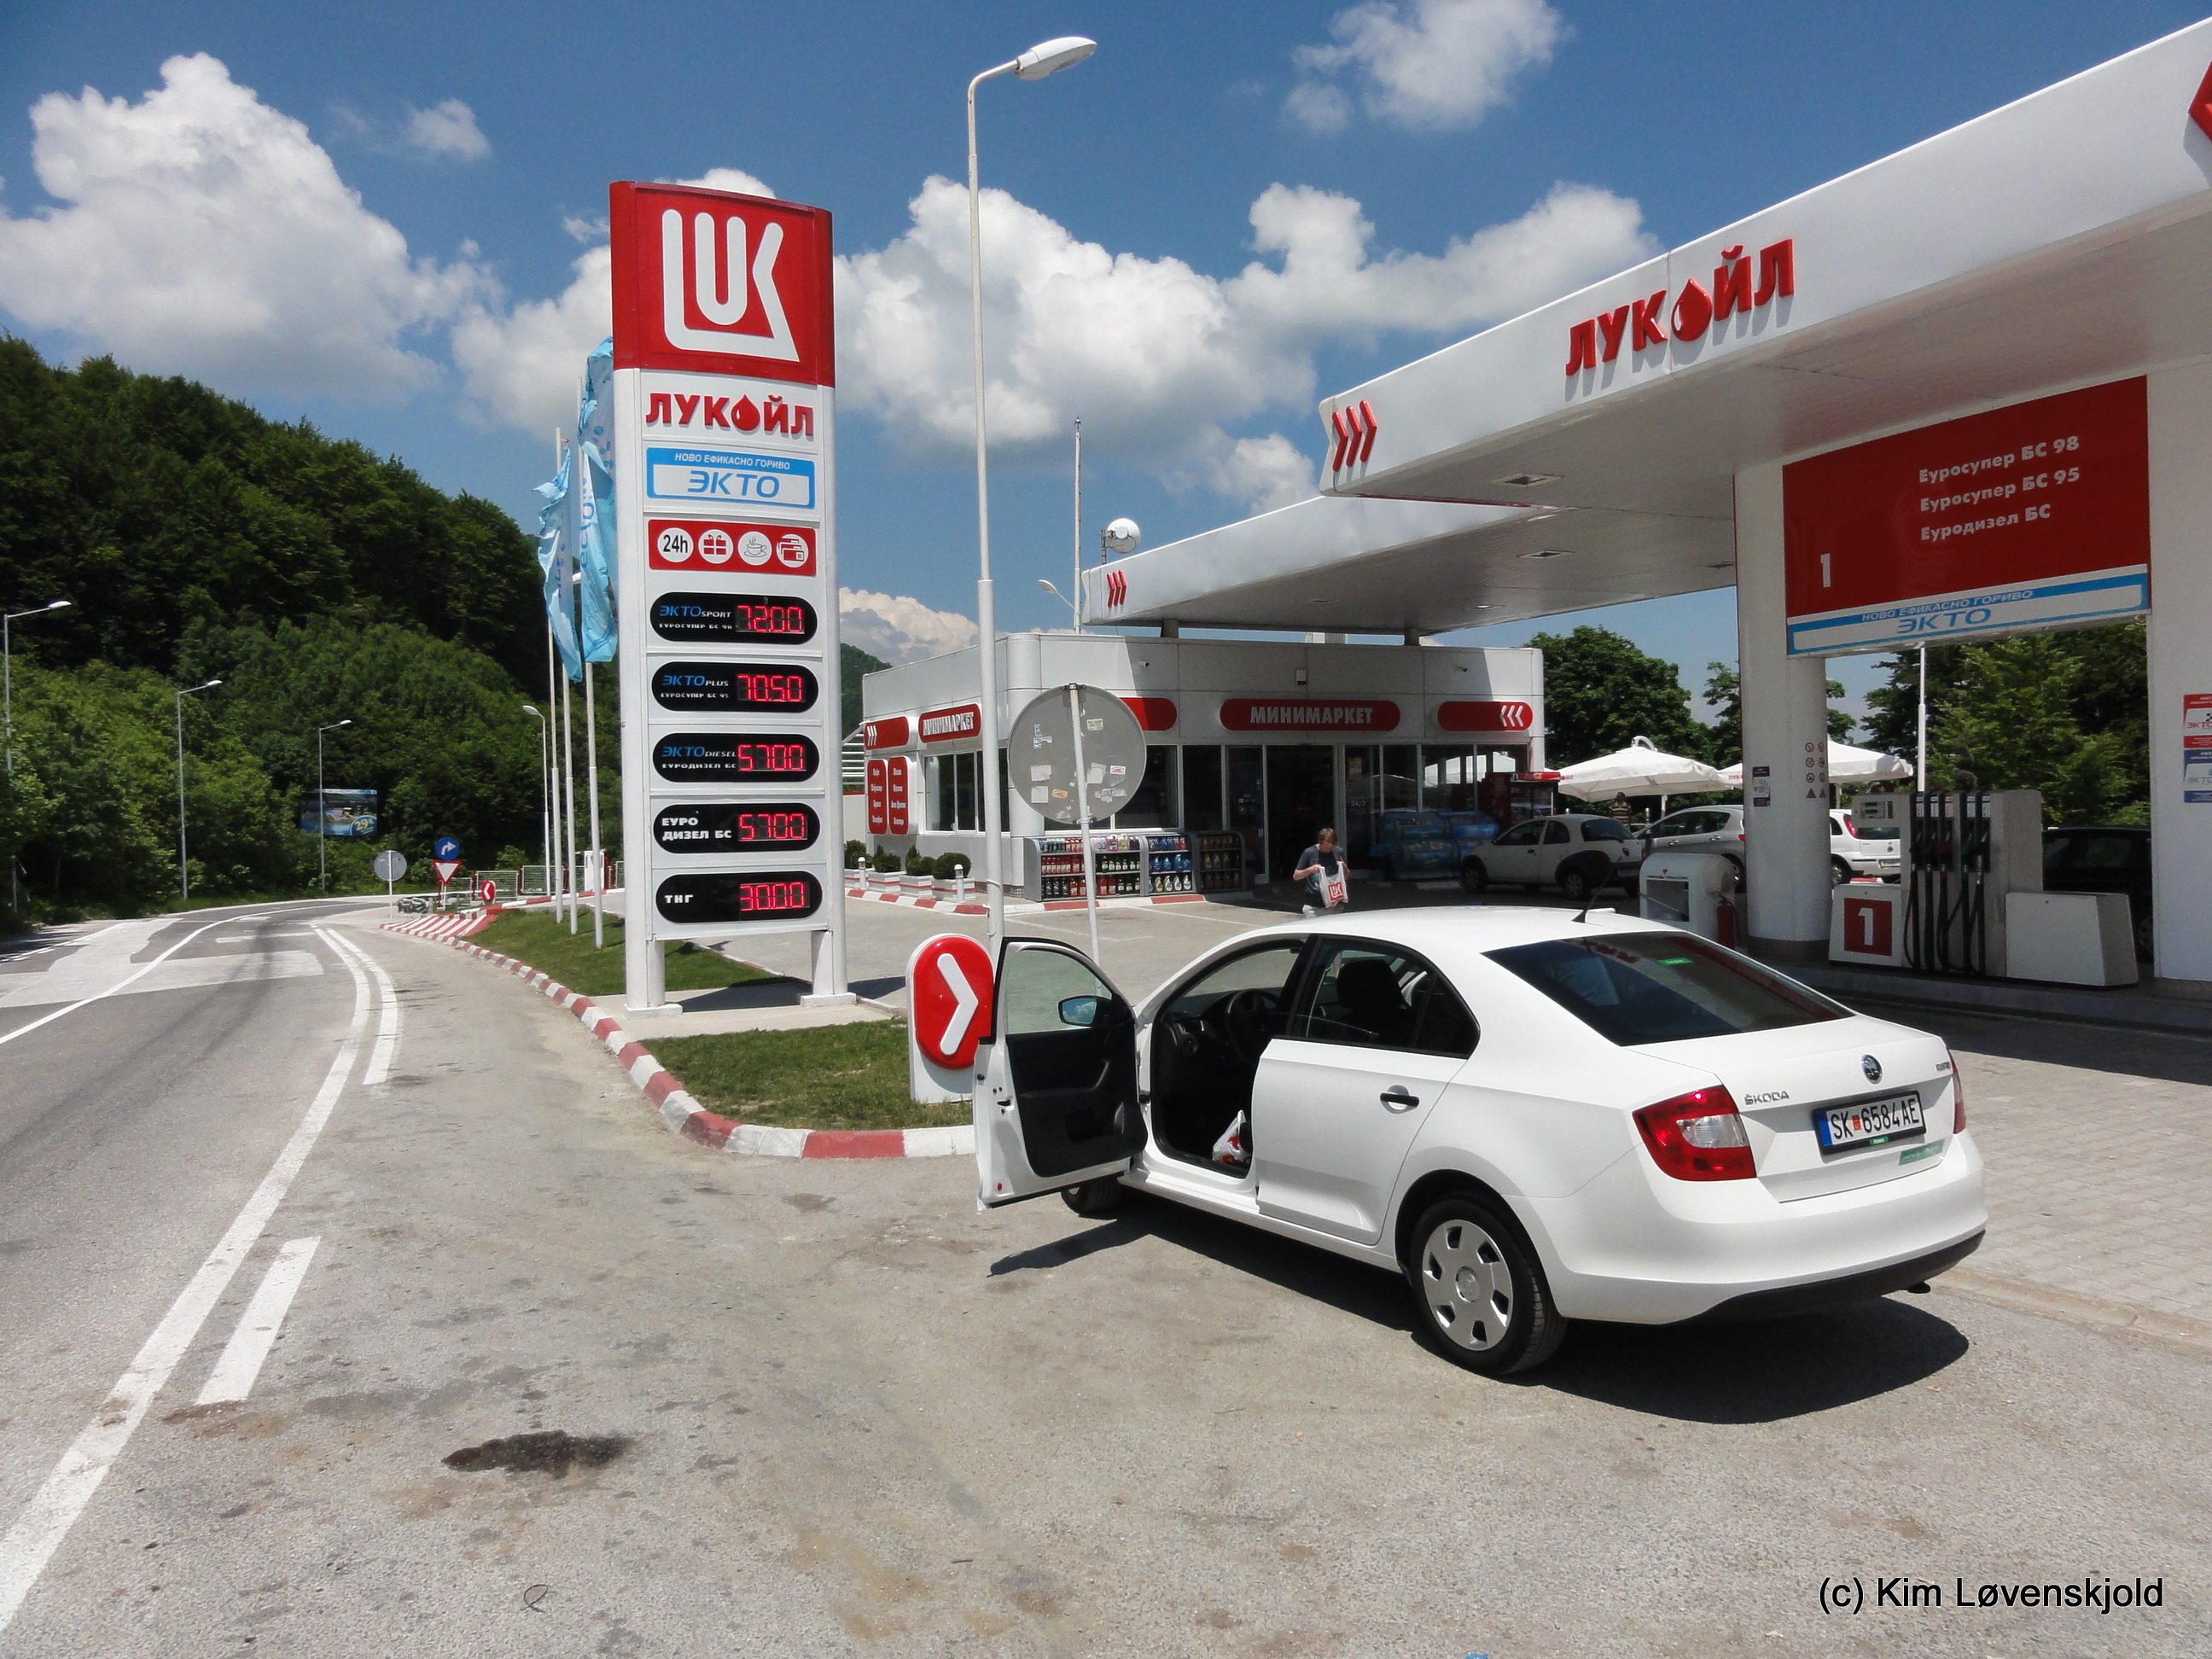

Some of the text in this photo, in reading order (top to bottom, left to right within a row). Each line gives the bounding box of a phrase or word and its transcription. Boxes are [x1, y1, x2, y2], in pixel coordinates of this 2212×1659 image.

[675, 452, 790, 470] НОВО ЕФИКАСНО ГОРИВО
[1919, 435, 2079, 484] Еуросупер БС 98
[687, 469, 780, 498] ЭКТО
[1920, 467, 2080, 513] Еуросупер БС 95
[1921, 504, 2051, 542] Еуродизел БС
[663, 534, 689, 554] 24h
[1820, 552, 1831, 588] 1
[1862, 590, 2034, 621] НОВО ЕФИКАСНО ГОРИВО
[1896, 608, 1992, 634] ЭКТО
[923, 712, 974, 736] МИНИМАРКЕТ
[1250, 706, 1373, 725] МИНИМАРКЕТ
[661, 817, 698, 826] ЕУРО
[662, 830, 732, 841] ДИЗЕЛ БС
[664, 894, 694, 904] ТНГ
[1858, 907, 1873, 946] 1
